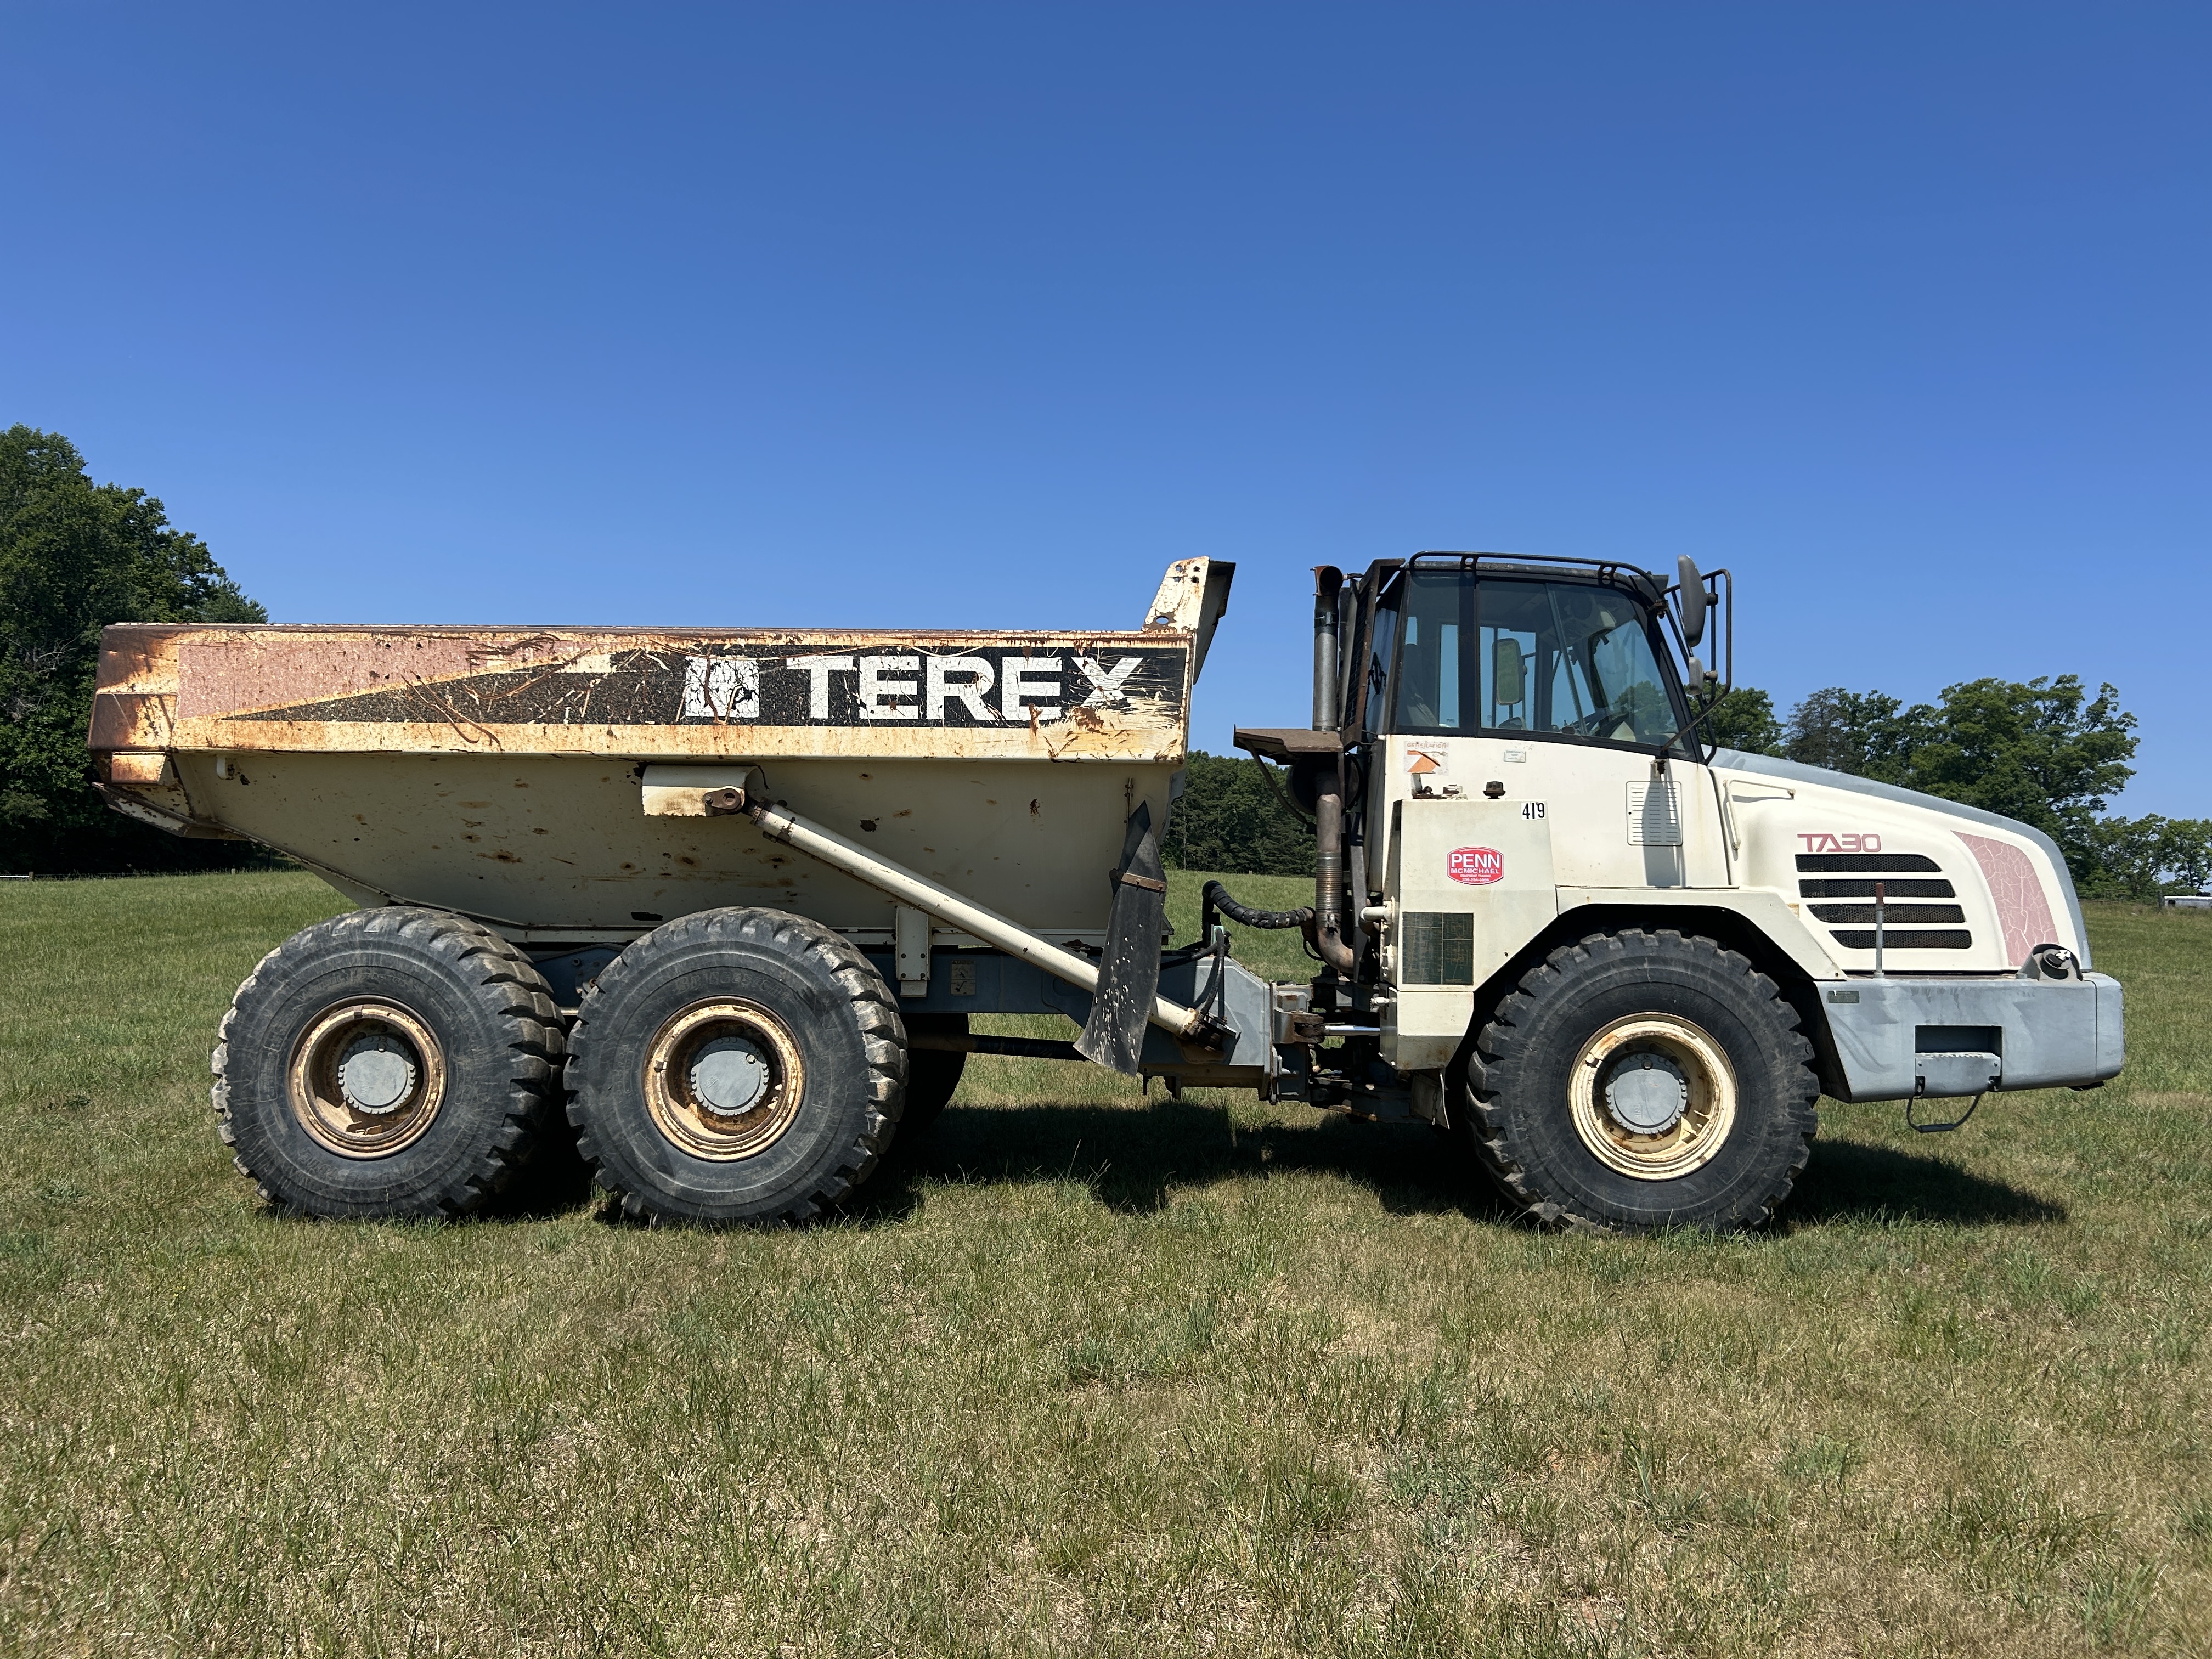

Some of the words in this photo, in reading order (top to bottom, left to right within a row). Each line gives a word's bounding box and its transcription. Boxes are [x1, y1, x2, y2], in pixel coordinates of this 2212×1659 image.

[786, 656, 1143, 721] TEREX
[1522, 802, 1545, 819] 419
[1797, 833, 1881, 853] TA30
[1451, 853, 1500, 868] PENN
